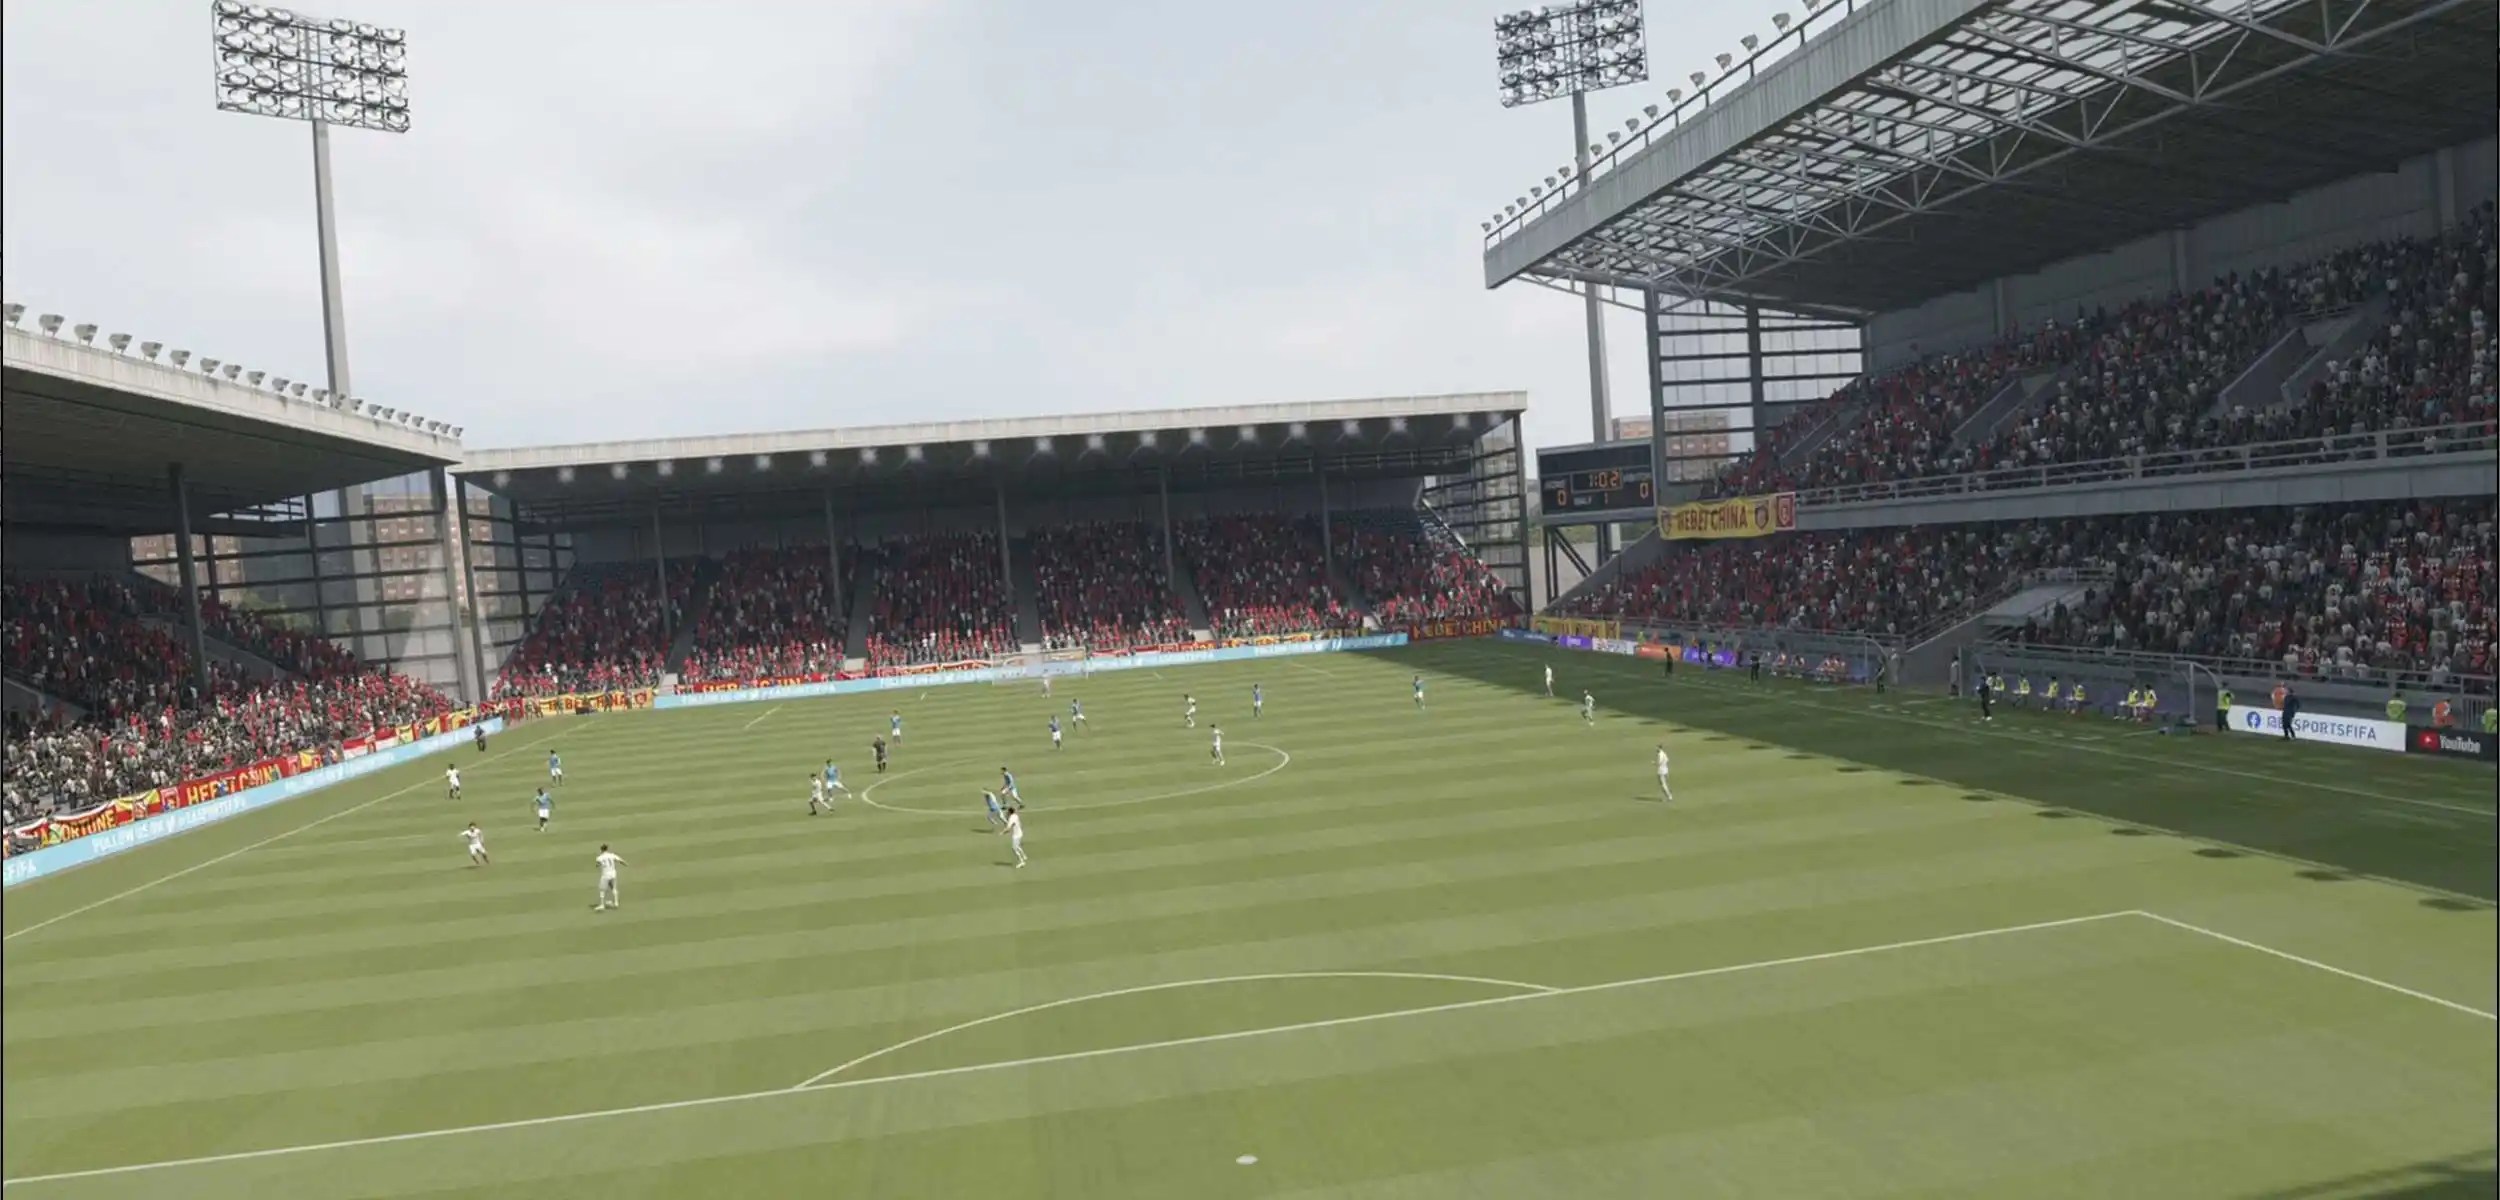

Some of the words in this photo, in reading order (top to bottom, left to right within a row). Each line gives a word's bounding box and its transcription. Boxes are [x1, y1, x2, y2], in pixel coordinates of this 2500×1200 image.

[1710, 505, 1749, 530] CHINA
[2267, 715, 2377, 740] @ESPORTSFIFA
[2440, 735, 2481, 754] YouTube
